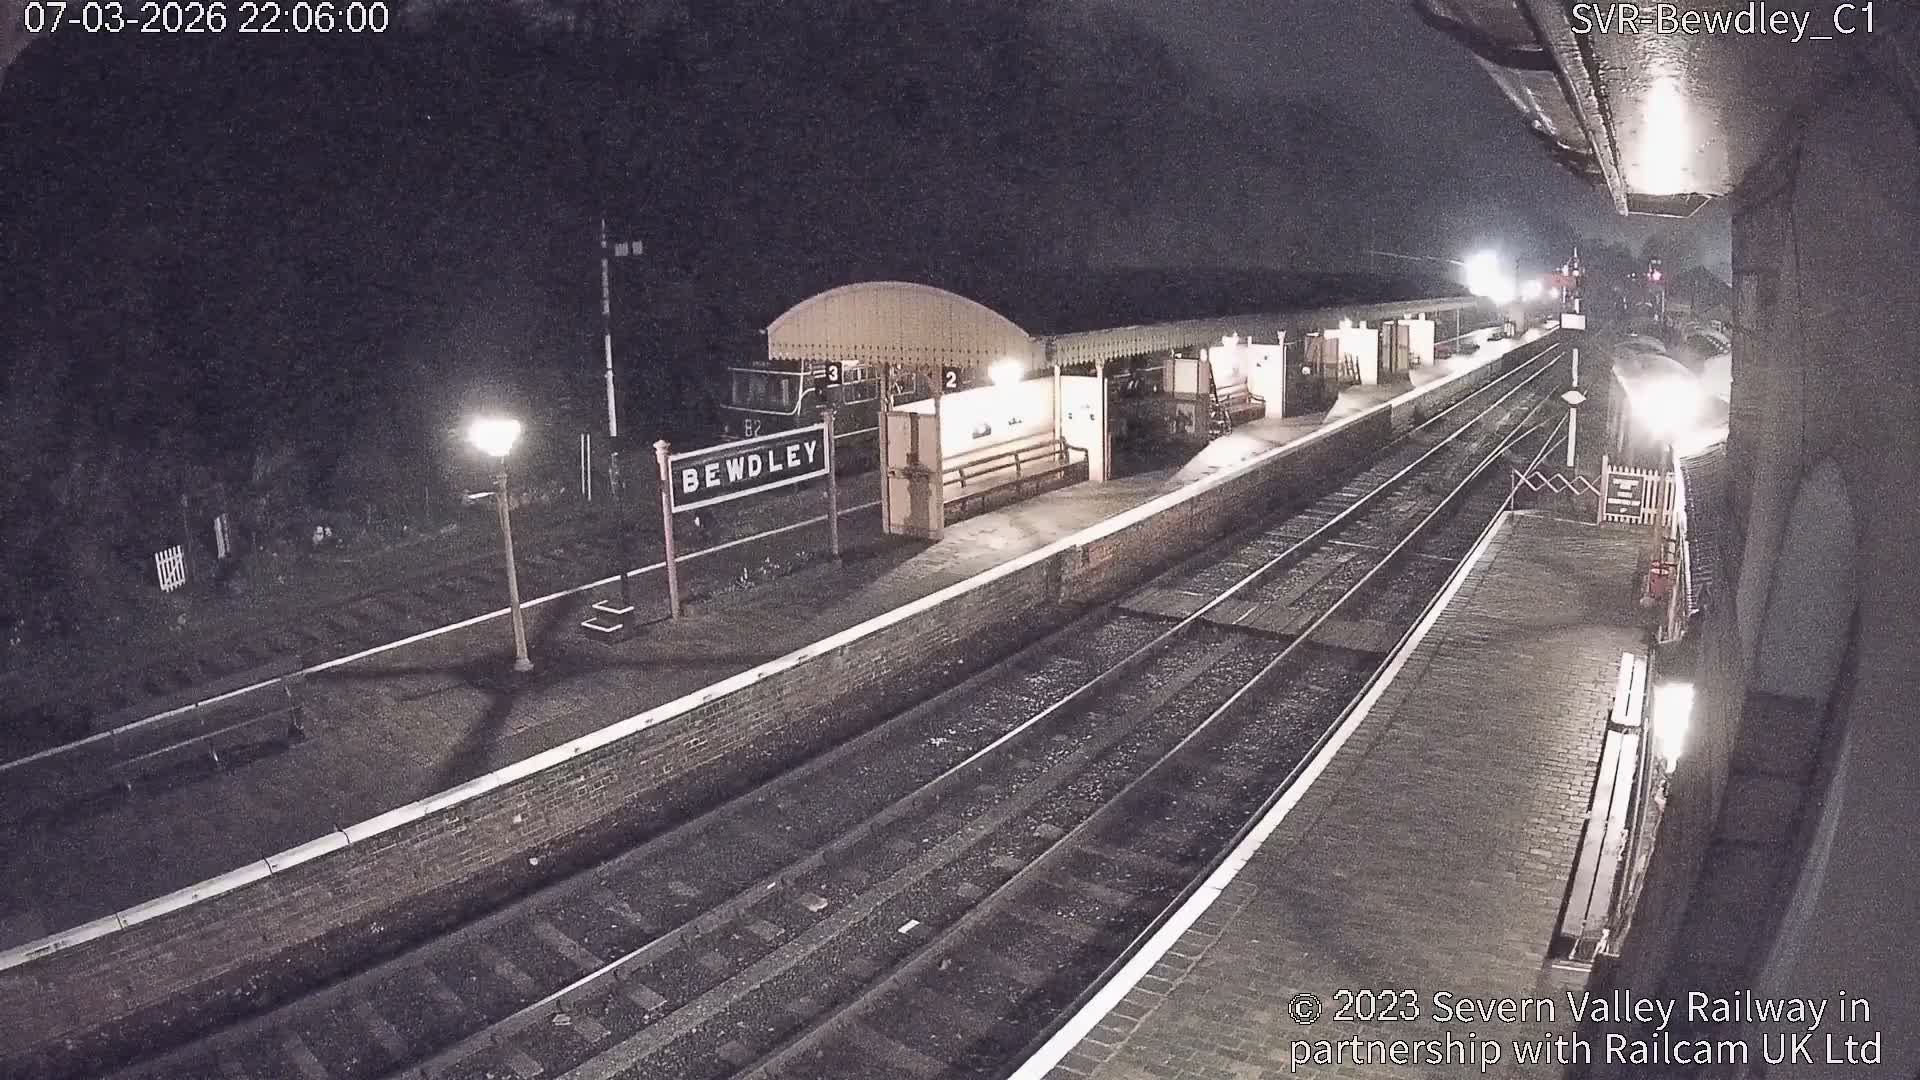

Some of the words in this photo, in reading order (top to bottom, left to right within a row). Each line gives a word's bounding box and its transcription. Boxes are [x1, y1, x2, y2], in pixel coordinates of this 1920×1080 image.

[828, 365, 839, 382] 3
[945, 371, 957, 388] 2
[682, 440, 817, 494] BEWDLEY
